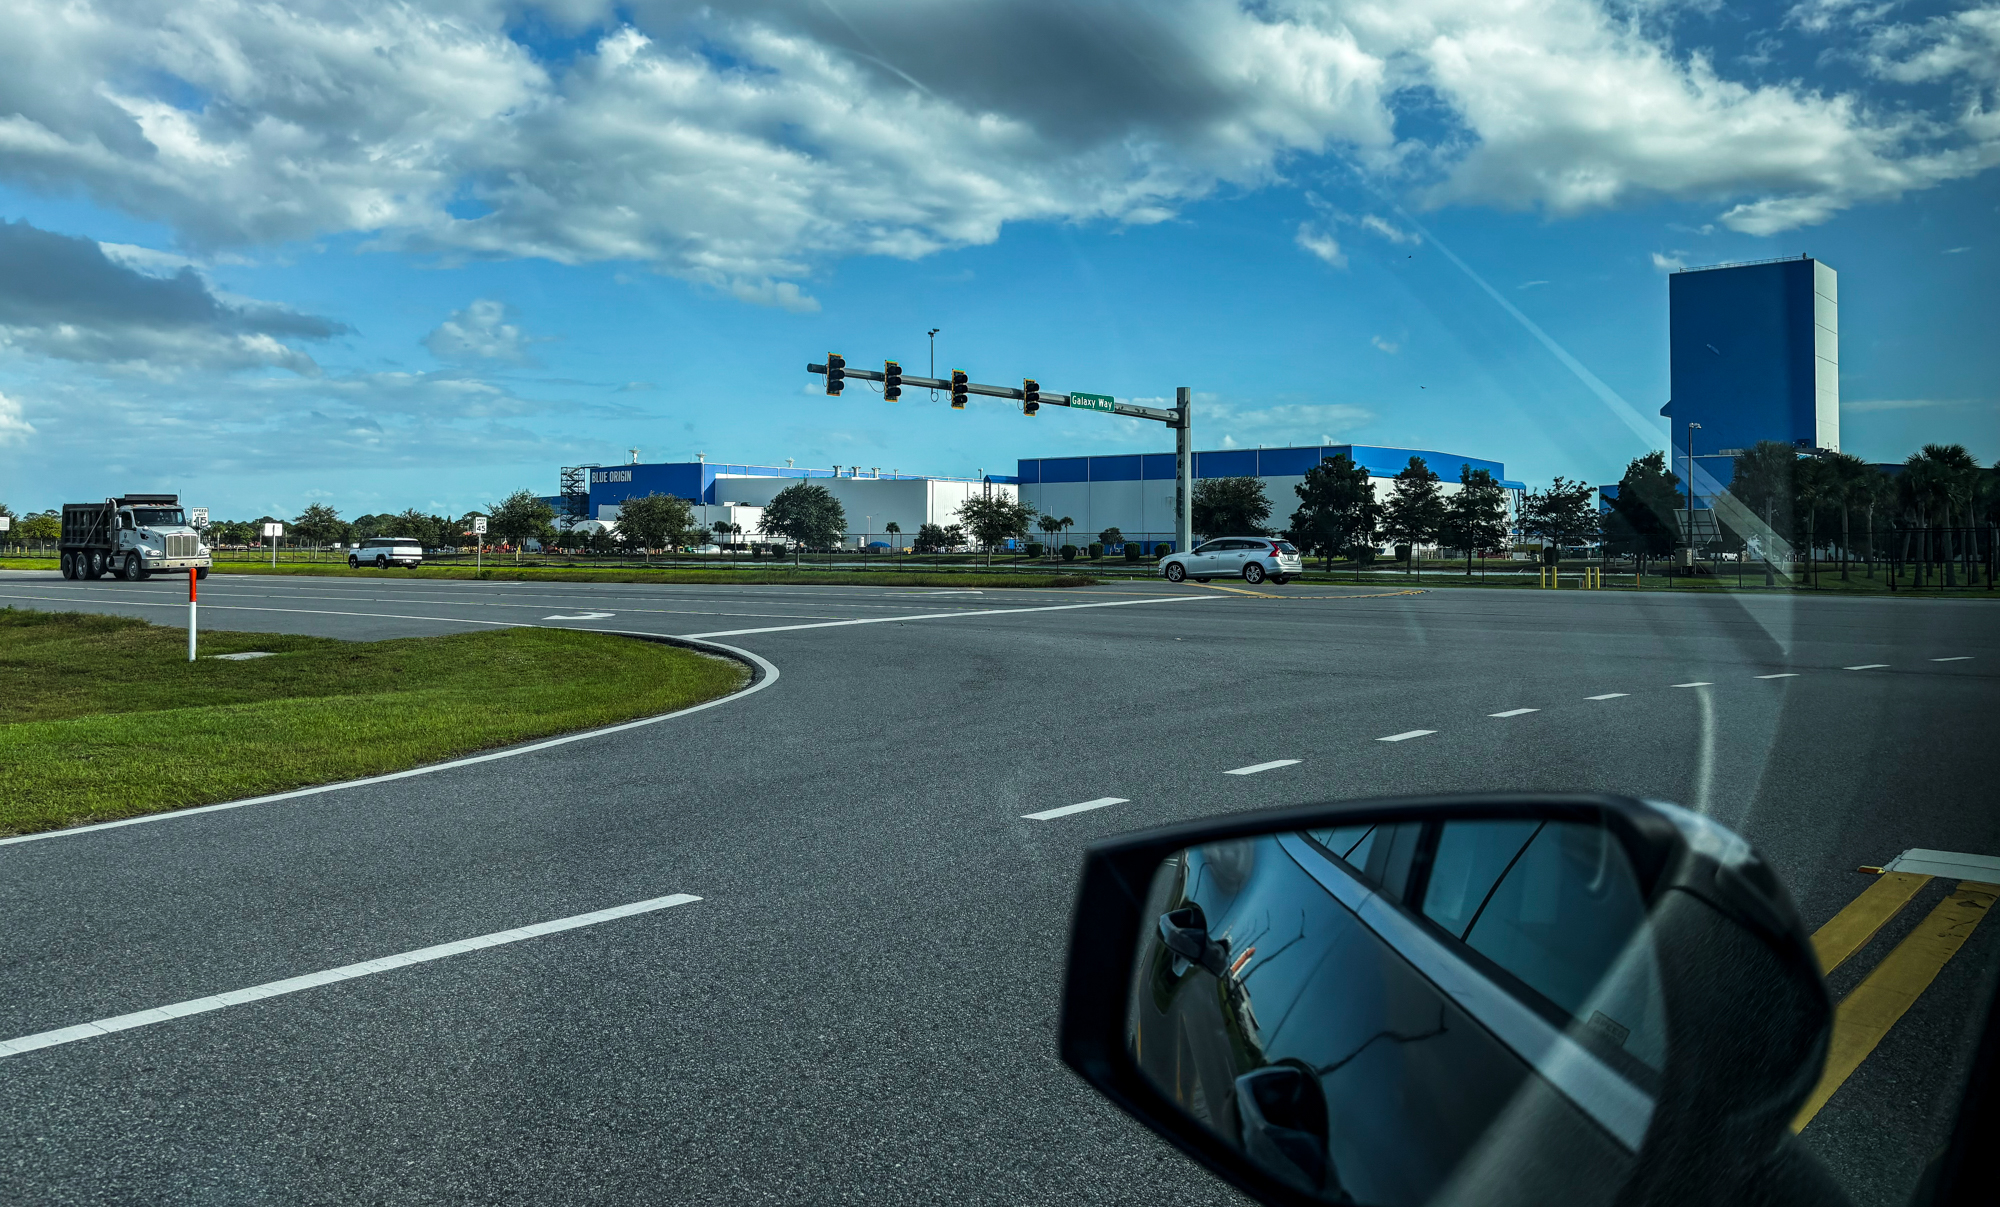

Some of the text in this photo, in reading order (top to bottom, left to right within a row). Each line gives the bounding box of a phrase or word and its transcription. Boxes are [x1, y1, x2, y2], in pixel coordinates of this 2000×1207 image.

[1072, 395, 1112, 410] Galaxy Way
[592, 470, 632, 483] BLUE ORIGIN
